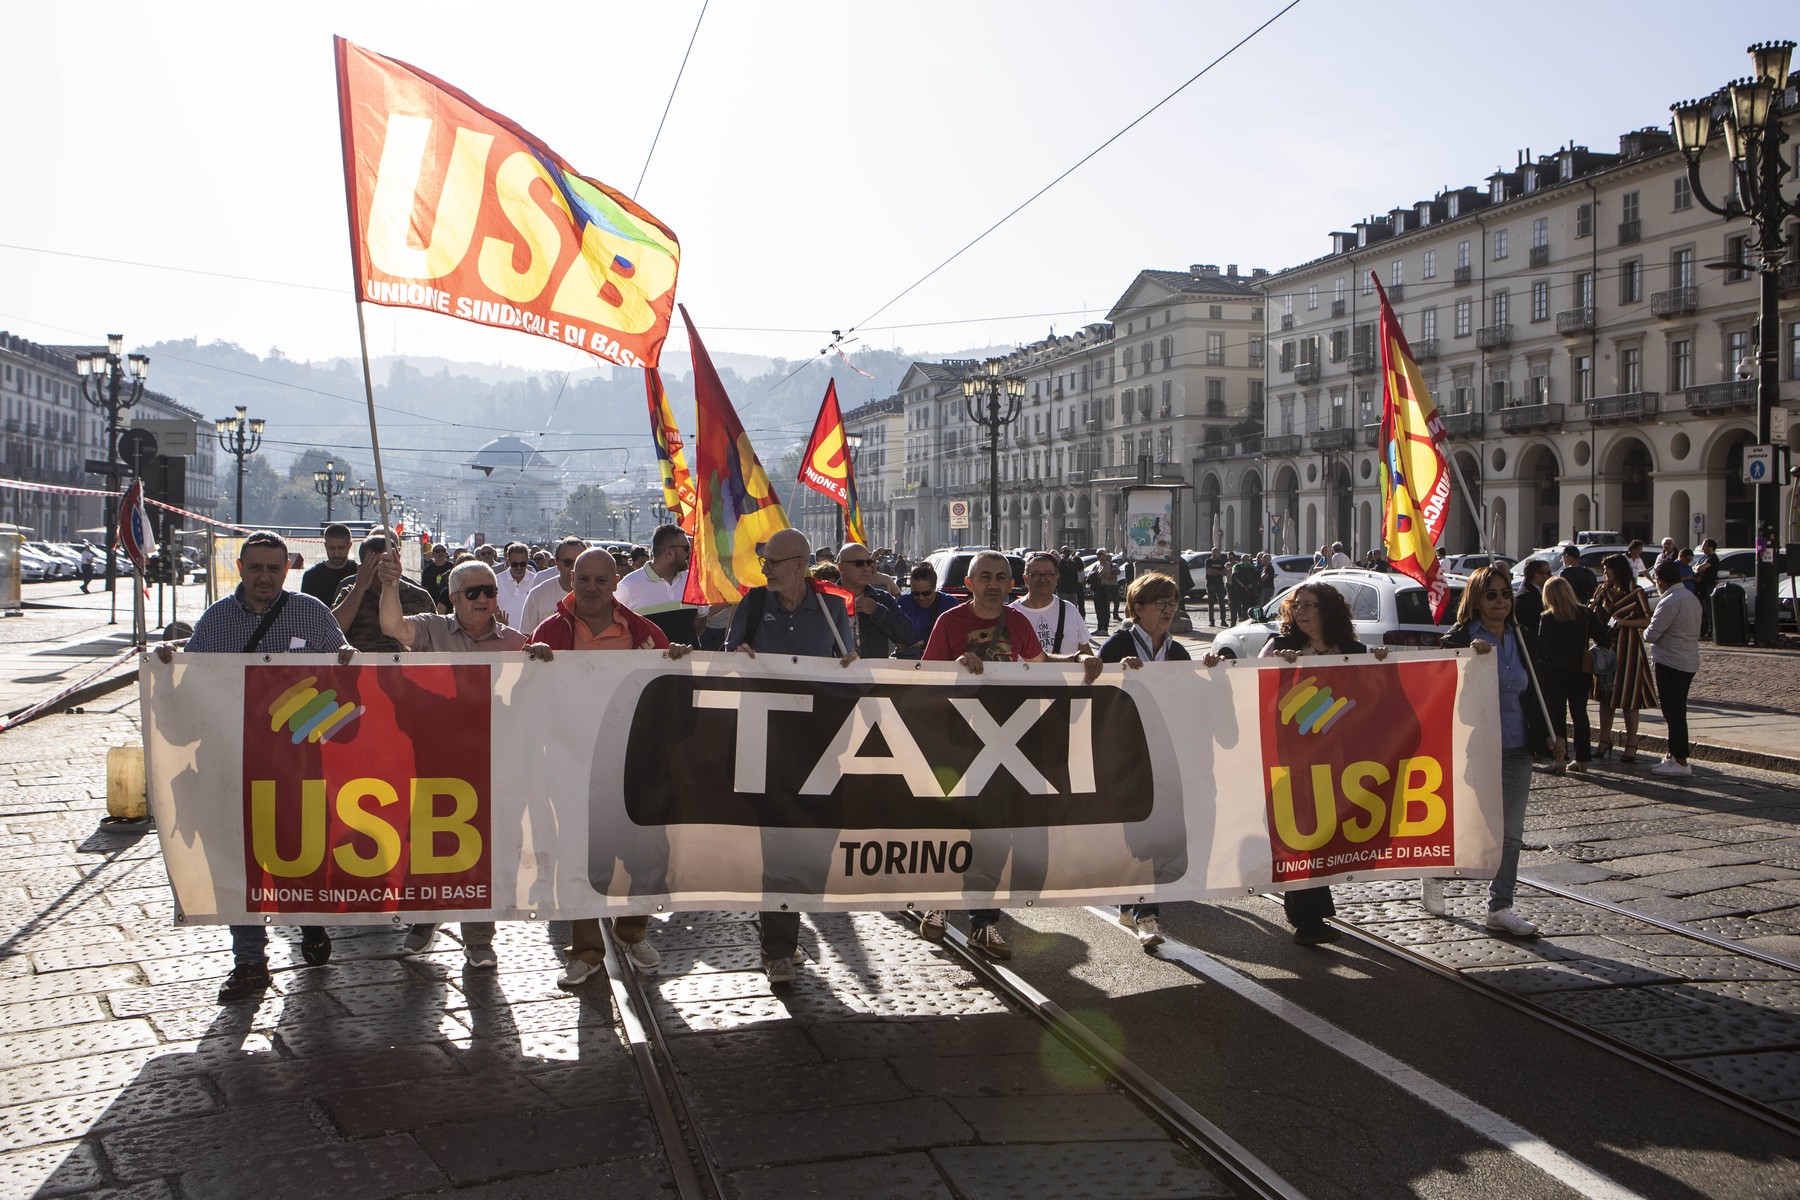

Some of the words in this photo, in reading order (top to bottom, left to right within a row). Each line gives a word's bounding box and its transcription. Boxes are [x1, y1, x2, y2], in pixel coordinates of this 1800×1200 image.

[367, 113, 678, 335] USB
[367, 280, 451, 313] UNIONE
[456, 296, 560, 341] SINDACALE
[564, 325, 584, 348] DI
[1037, 630, 1051, 639] THE
[1039, 637, 1056, 649] OAD
[692, 689, 1097, 798] TAXI
[251, 777, 483, 878] USB
[1270, 755, 1447, 851] USB
[839, 840, 974, 877] TORINO
[1276, 857, 1324, 873] UNIONE
[1327, 847, 1393, 867] SINDACALE
[1396, 847, 1411, 858] DI
[1413, 845, 1450, 857] BASE
[251, 887, 314, 902] UNIONE
[318, 887, 415, 903] SINDACALE
[420, 886, 438, 900] DI
[442, 885, 487, 899] BASE
